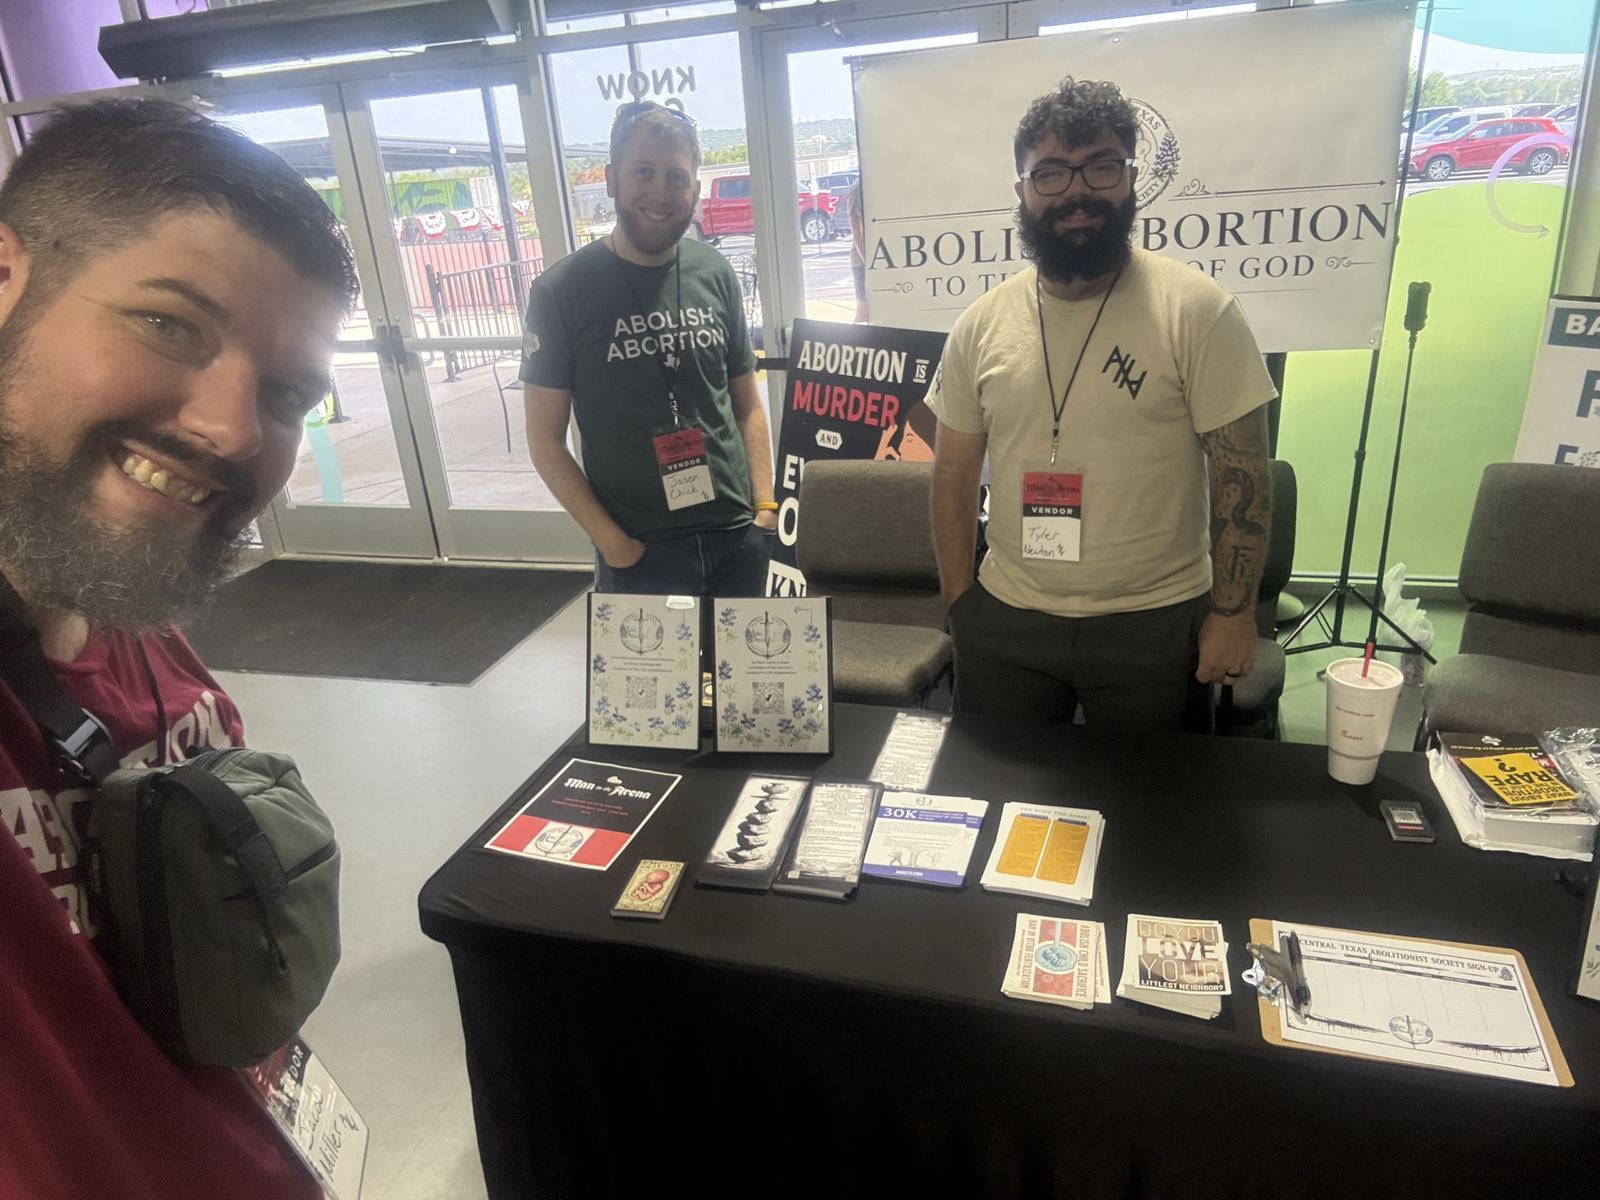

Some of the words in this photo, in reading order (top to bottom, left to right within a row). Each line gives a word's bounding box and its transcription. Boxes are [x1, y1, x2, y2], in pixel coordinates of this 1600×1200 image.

[1136, 180, 1159, 202] CIETY
[869, 227, 1035, 270] ABOLI
[1140, 201, 1394, 252] BORTION
[926, 275, 966, 297] TO
[1239, 254, 1315, 280] GOD
[614, 306, 715, 338] ABOLISH
[606, 328, 726, 363] ABORTION
[797, 340, 908, 384] ABORTION
[914, 363, 927, 380] IS
[792, 379, 900, 428] MURDER
[819, 432, 839, 446] AND
[666, 458, 701, 471] VENDOR
[1031, 506, 1073, 515] VENDOR
[1028, 525, 1060, 543] Tyler
[1023, 543, 1055, 558] Newton
[564, 778, 595, 790] Man
[608, 786, 652, 800] Arena
[1484, 770, 1556, 787] RAPE
[1503, 786, 1567, 797] ABORTION
[882, 807, 918, 819] 30K
[1139, 921, 1167, 938] DO
[1172, 927, 1215, 942] YOU
[1140, 937, 1219, 960] LOVE
[1299, 938, 1337, 950] CENTRAL
[1339, 944, 1368, 954] TEXAS
[1370, 948, 1429, 963] ABOLITIONIST
[1431, 956, 1466, 969] SOCIETY
[1467, 962, 1500, 974] SIGN-UP
[1140, 957, 1221, 985] YOUR
[1141, 979, 1178, 989] LITTLEST
[1179, 982, 1224, 992] NEIGHBOR?
